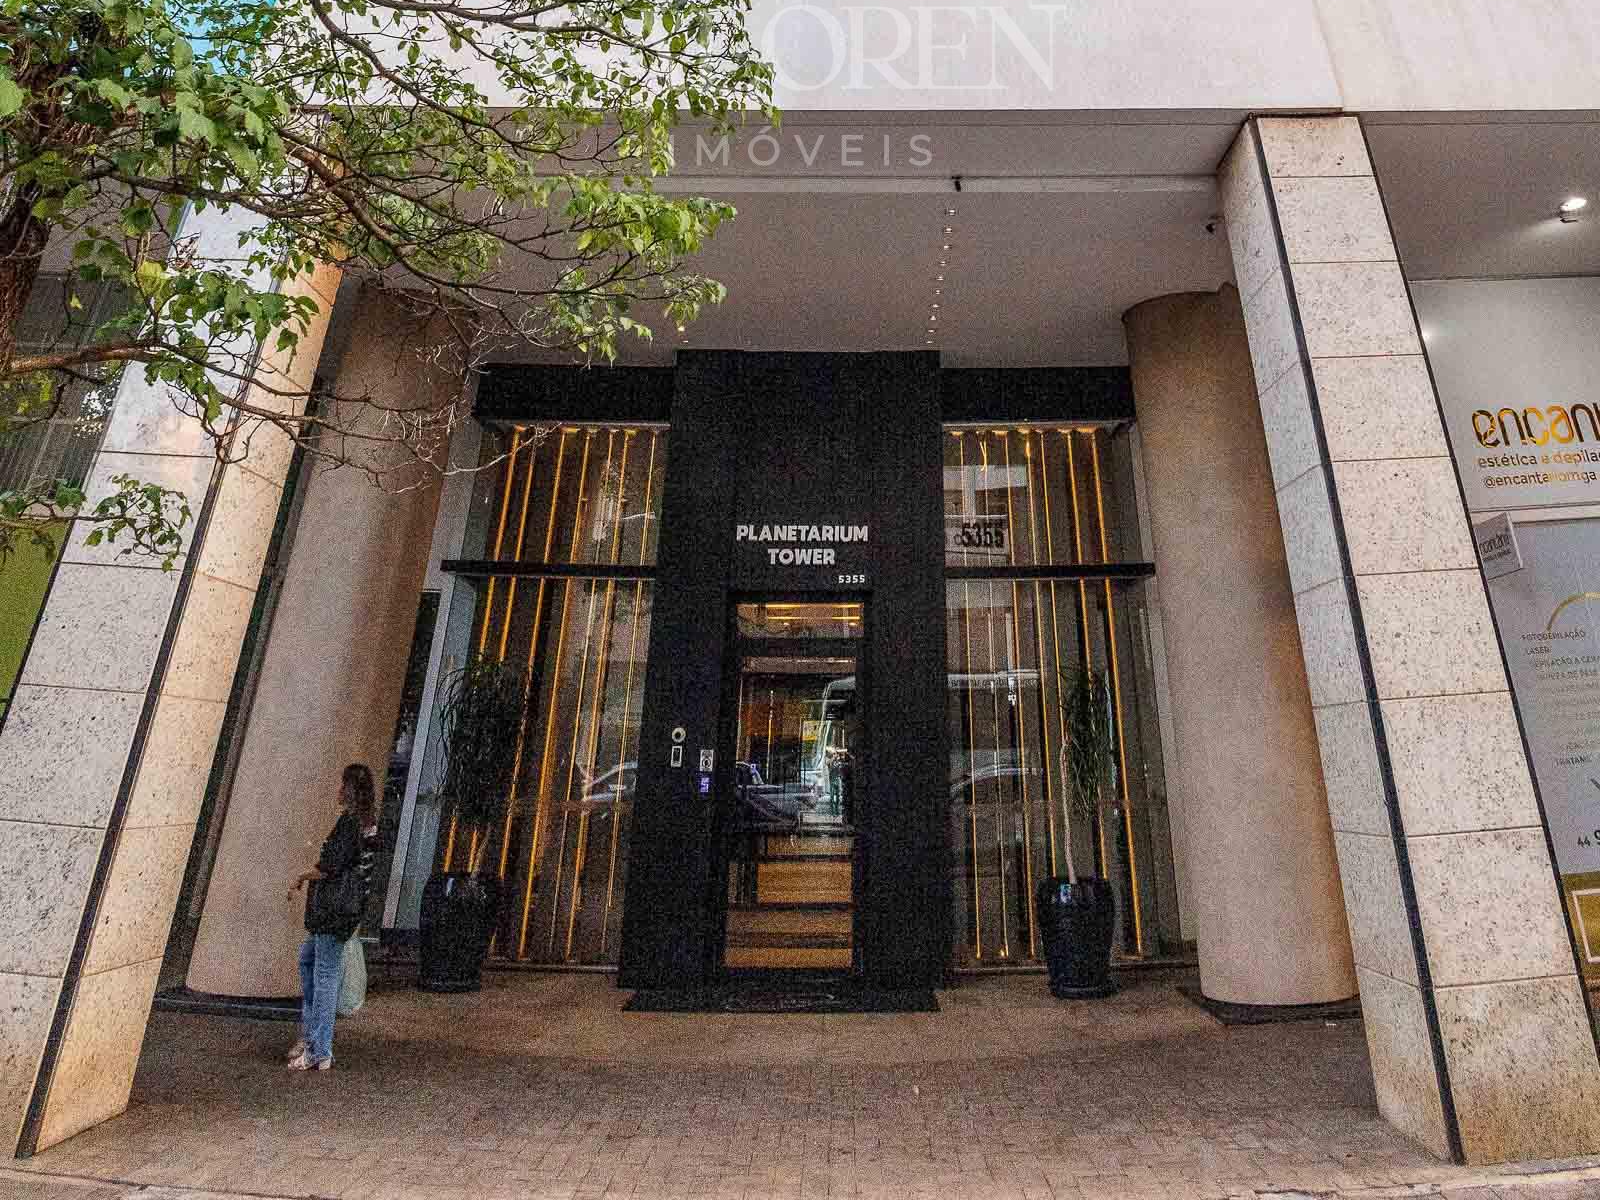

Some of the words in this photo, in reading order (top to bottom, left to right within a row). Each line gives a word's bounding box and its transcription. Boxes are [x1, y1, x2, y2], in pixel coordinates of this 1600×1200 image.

[1478, 453, 1538, 468] estética
[1552, 449, 1600, 466] depila
[736, 525, 869, 542] PLANETARIUM
[767, 548, 836, 565] TOWER
[838, 574, 866, 584] 5355
